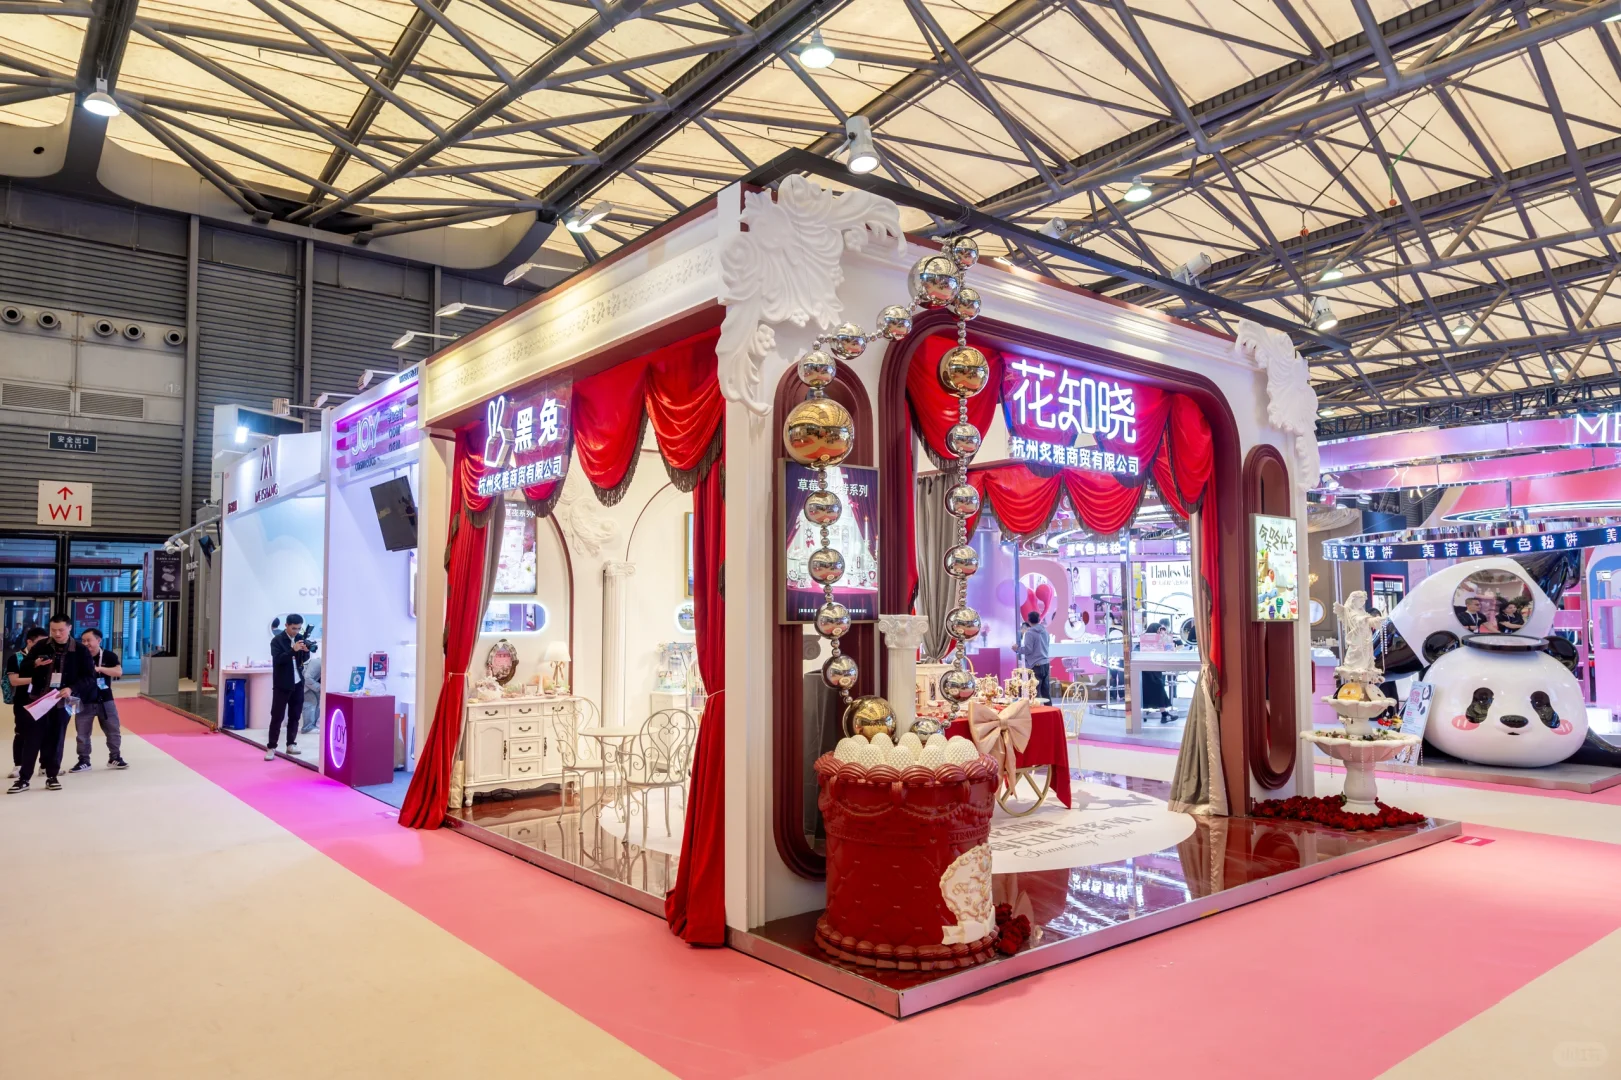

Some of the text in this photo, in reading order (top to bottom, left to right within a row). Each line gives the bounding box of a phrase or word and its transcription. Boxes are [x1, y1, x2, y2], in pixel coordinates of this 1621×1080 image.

[1011, 359, 1137, 443] 花知晓
[57, 435, 89, 445] 安全出口
[351, 411, 381, 456] JOY
[514, 398, 559, 452] 黑兔
[477, 455, 562, 496] 杭州炙雅商贸有限公司
[1012, 436, 1139, 476] 杭州炙雅商贸有限公司
[48, 503, 83, 521] W1
[1606, 527, 1618, 543] 美
[85, 603, 95, 615] 6
